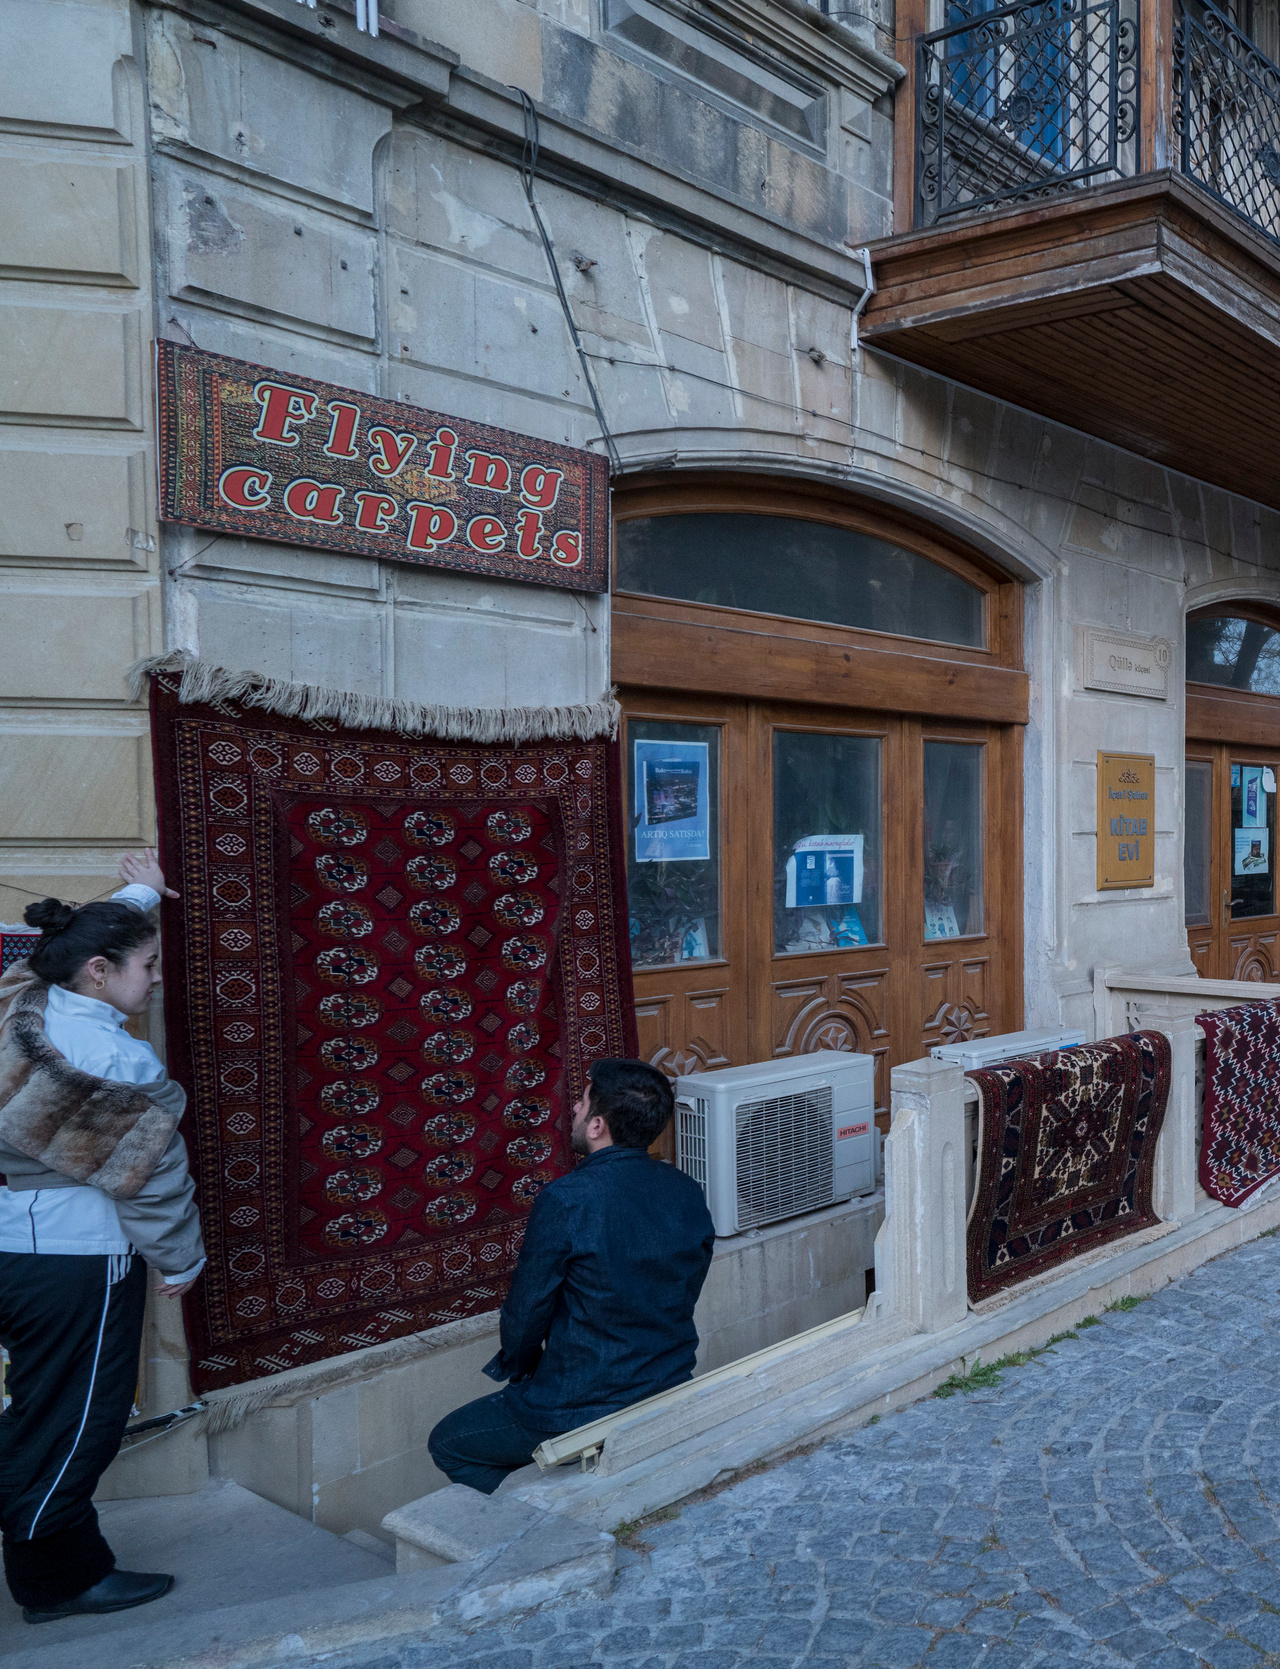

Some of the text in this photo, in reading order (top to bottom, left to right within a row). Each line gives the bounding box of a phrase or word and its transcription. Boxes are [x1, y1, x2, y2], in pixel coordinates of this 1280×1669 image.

[253, 381, 564, 509] Flying
[1158, 649, 1167, 662] 10
[1110, 813, 1148, 837] KİTAB
[641, 830, 668, 840] ARTIQ
[1118, 838, 1140, 861] EVİ
[840, 1124, 867, 1137] HITACHI
